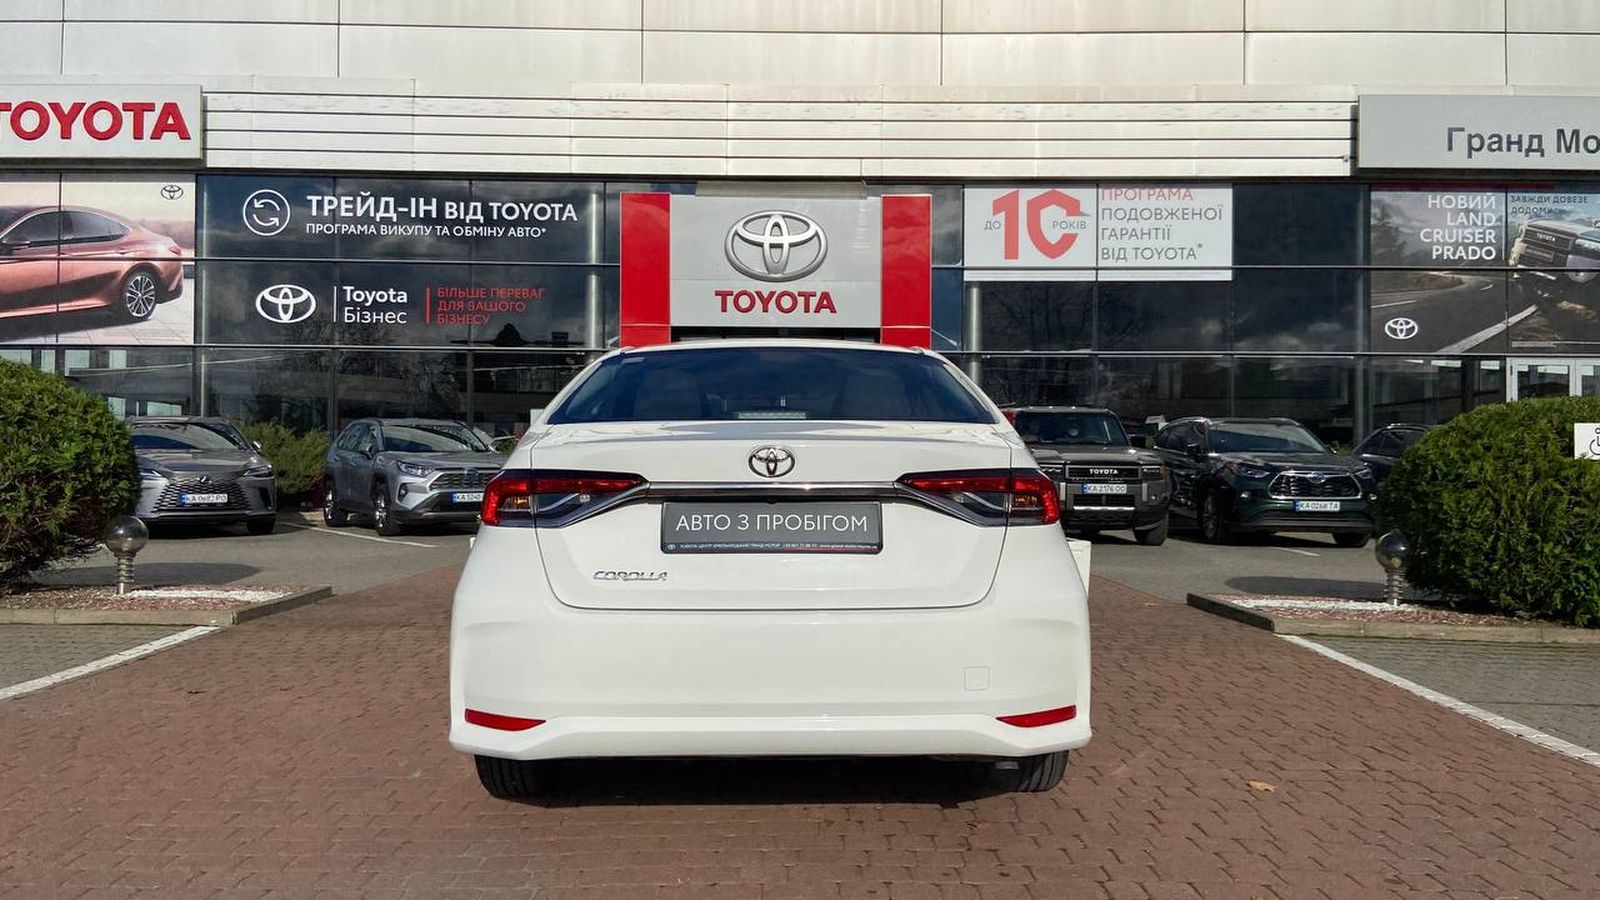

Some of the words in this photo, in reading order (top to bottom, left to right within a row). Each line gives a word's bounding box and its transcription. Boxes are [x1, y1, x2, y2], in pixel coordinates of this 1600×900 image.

[1447, 127, 1546, 159] Гранд
[1101, 188, 1194, 201] ПРОГРАМА
[1427, 192, 1497, 209] НОВИЙ
[1510, 194, 1551, 204] ЗАВЖДИ
[1553, 195, 1589, 204] ДОВЕЗЕ
[306, 191, 437, 222] ТРЕЙД-ІН
[445, 201, 484, 223] ВІД
[489, 202, 578, 221] TOYOTA
[1101, 204, 1224, 222] ПОДОВЖЕНОЇ
[983, 220, 1001, 231] ДО
[1052, 219, 1087, 230] РОКІВ
[1446, 211, 1496, 227] LAND
[306, 223, 379, 236] ПРОГРАМА
[381, 224, 432, 238] ВИКУПУ
[435, 225, 452, 237] ТА
[453, 225, 505, 239] ОБМІНУ
[1101, 225, 1172, 241] ГАРАНТІЇ
[1420, 228, 1497, 243] CRUISER
[1101, 246, 1128, 262] ВІД
[1431, 245, 1497, 261] PRADO
[343, 286, 408, 307] Toyota
[437, 287, 487, 299] БІЛЬШЕ
[490, 287, 545, 300] ПЕРЕВАГ
[437, 300, 469, 312] ДЛЯ
[473, 300, 526, 312] ВАШОГО
[714, 290, 837, 314] TOYOTA
[344, 307, 408, 324] Бізнес
[437, 313, 491, 325] БІЗНЕСУ
[675, 514, 731, 531] АВТО
[737, 514, 750, 531] З
[757, 514, 869, 532] ПРОБІГОМ
[592, 570, 668, 581] COROLLA
